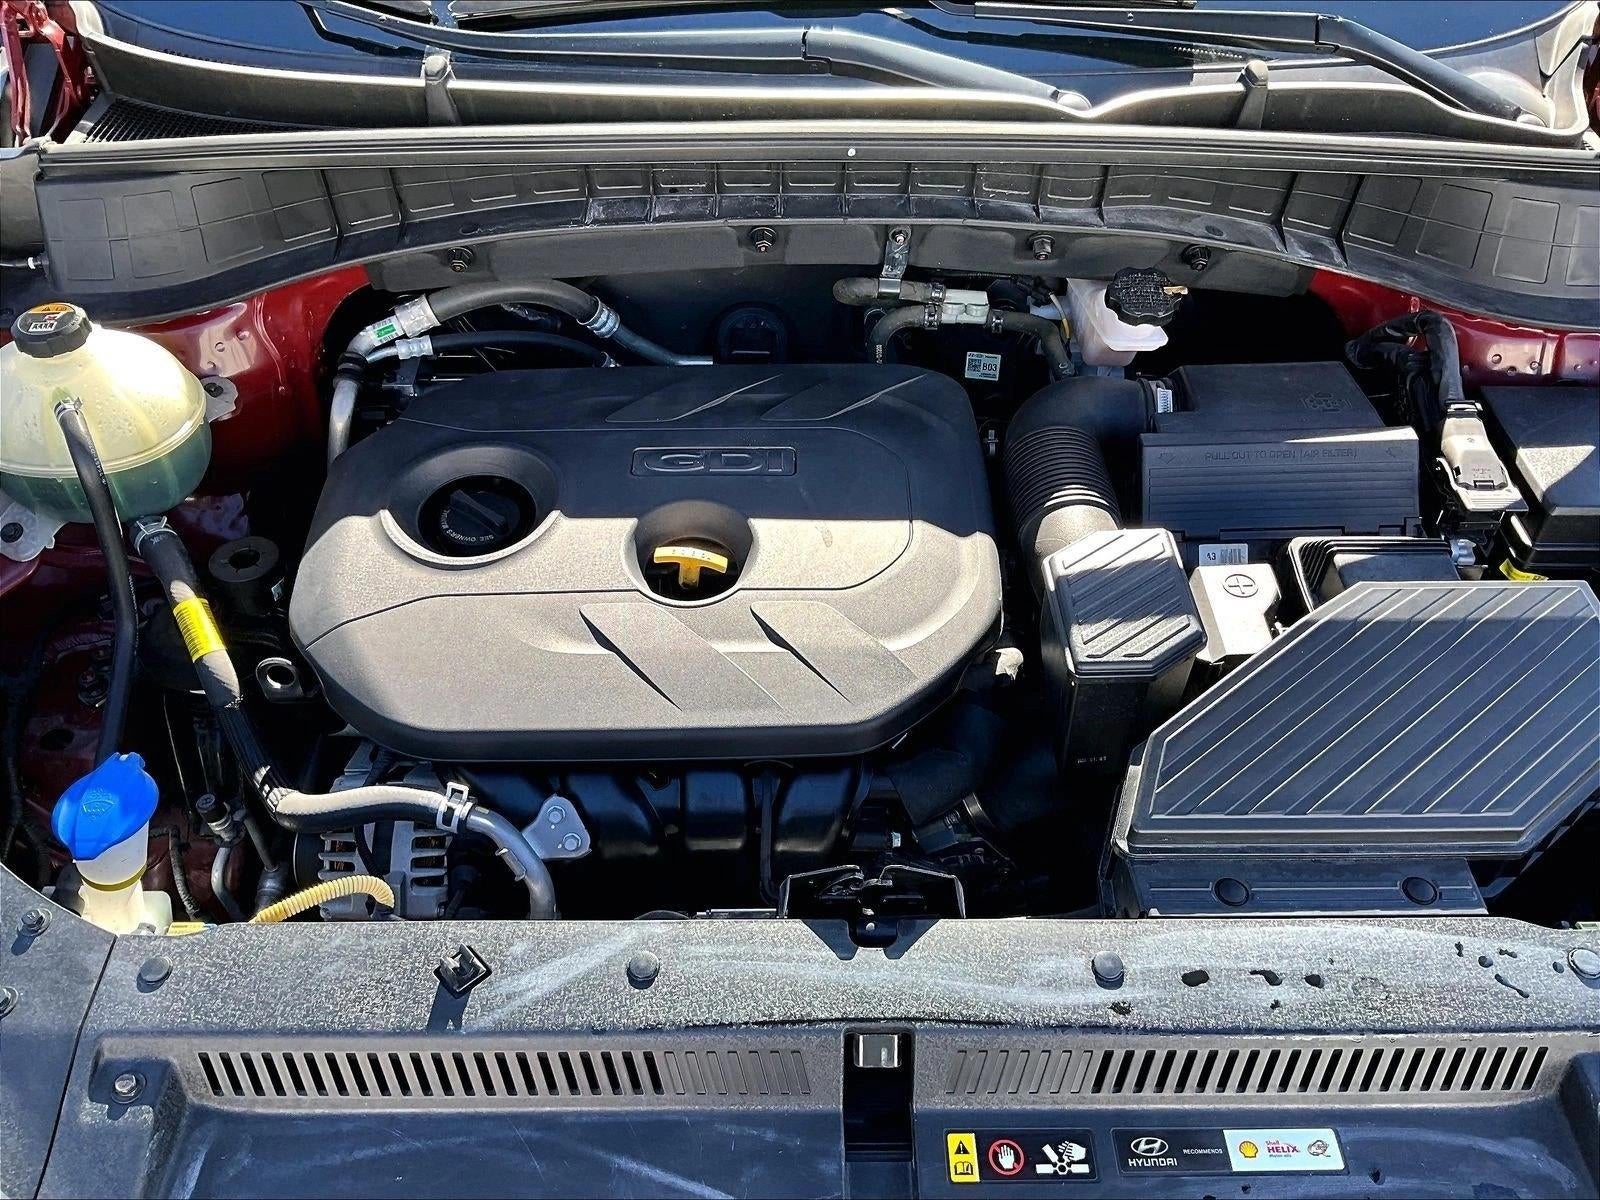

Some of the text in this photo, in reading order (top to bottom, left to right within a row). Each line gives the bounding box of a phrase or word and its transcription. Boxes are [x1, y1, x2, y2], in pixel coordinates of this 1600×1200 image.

[982, 362, 998, 372] B03
[1204, 451, 1230, 461] PULL
[1231, 451, 1251, 460] OUT
[1269, 450, 1297, 459] OPEN
[644, 450, 784, 472] GDI
[1267, 1145, 1299, 1154] HELIX
[1128, 1157, 1178, 1167] HYUNDAI
